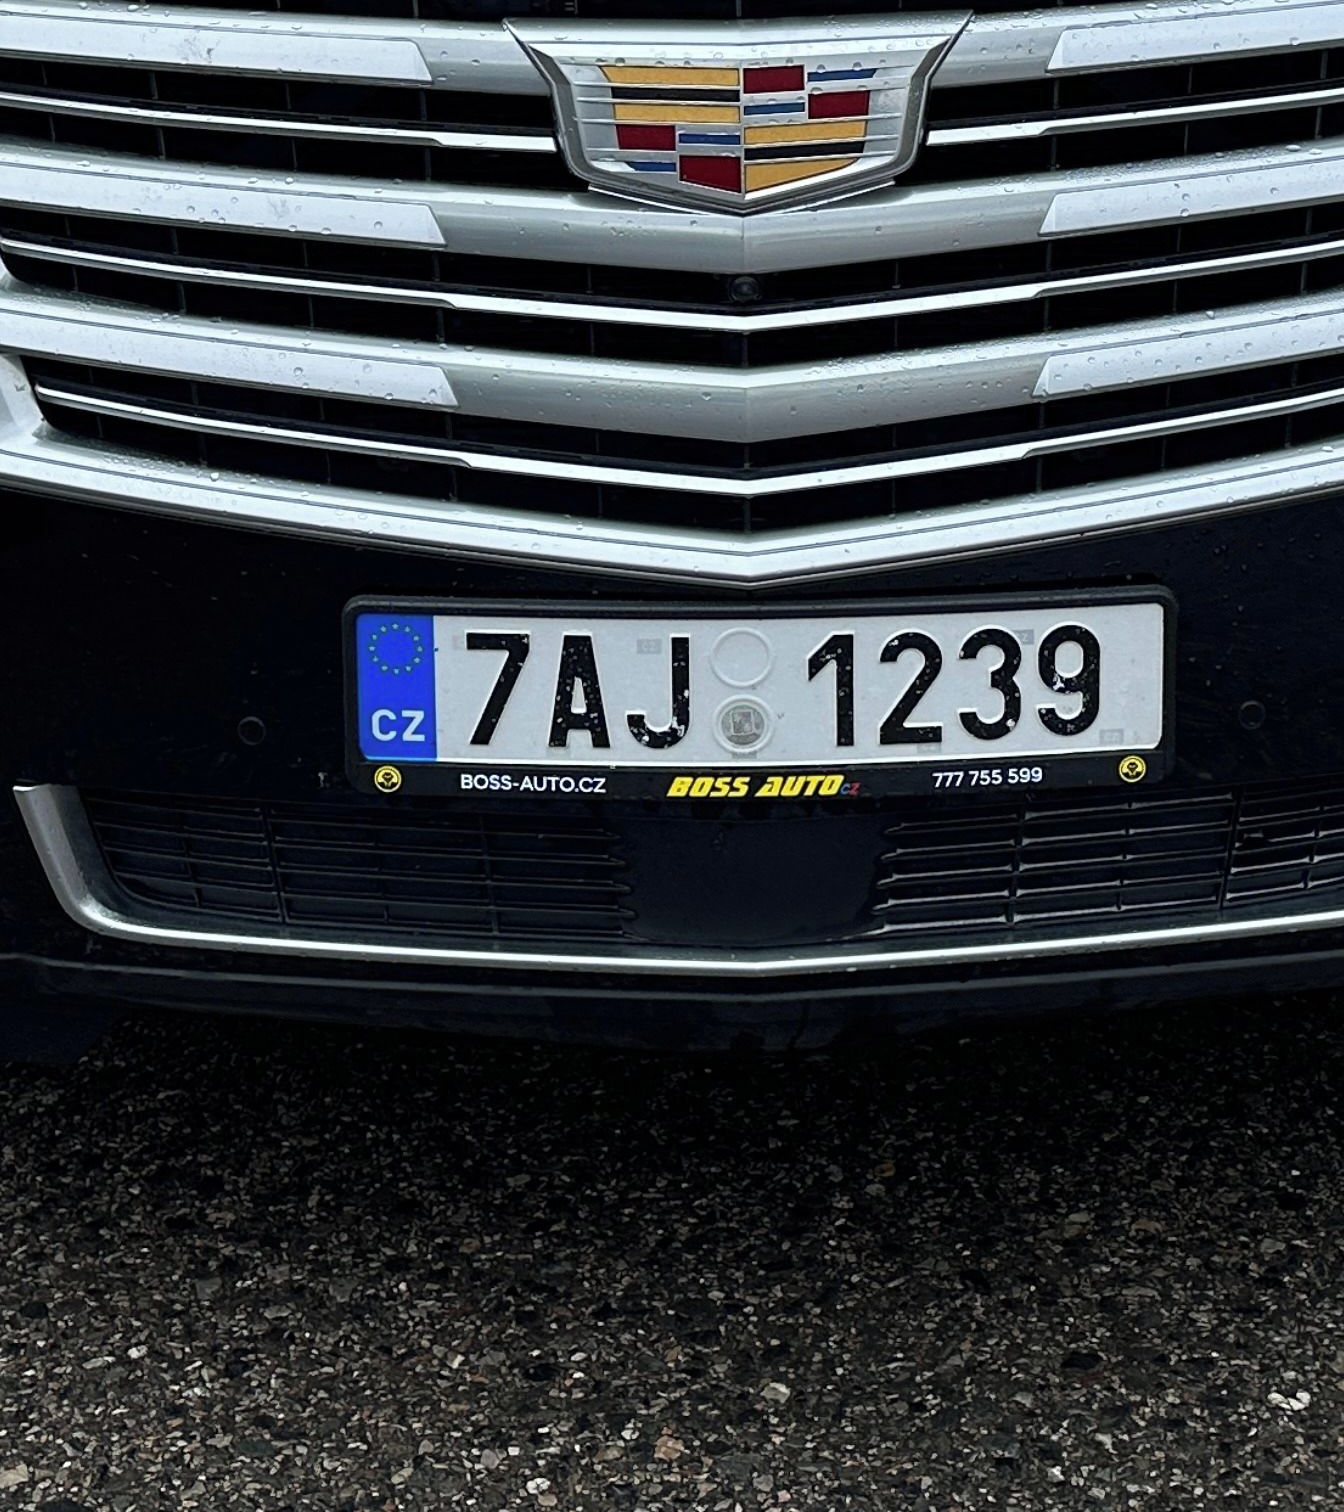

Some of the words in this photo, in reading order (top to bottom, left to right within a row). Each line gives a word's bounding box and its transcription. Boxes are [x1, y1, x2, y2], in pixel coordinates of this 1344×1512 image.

[371, 709, 426, 742] CZ
[465, 632, 690, 749] 7AJ
[807, 623, 1101, 747] 1239
[460, 773, 607, 794] BOSS-AUTO.CZ
[666, 776, 751, 797] BOSS
[754, 774, 845, 797] AUTO
[932, 771, 964, 788] 777
[968, 769, 1003, 786] 755
[1007, 767, 1043, 784] 599
